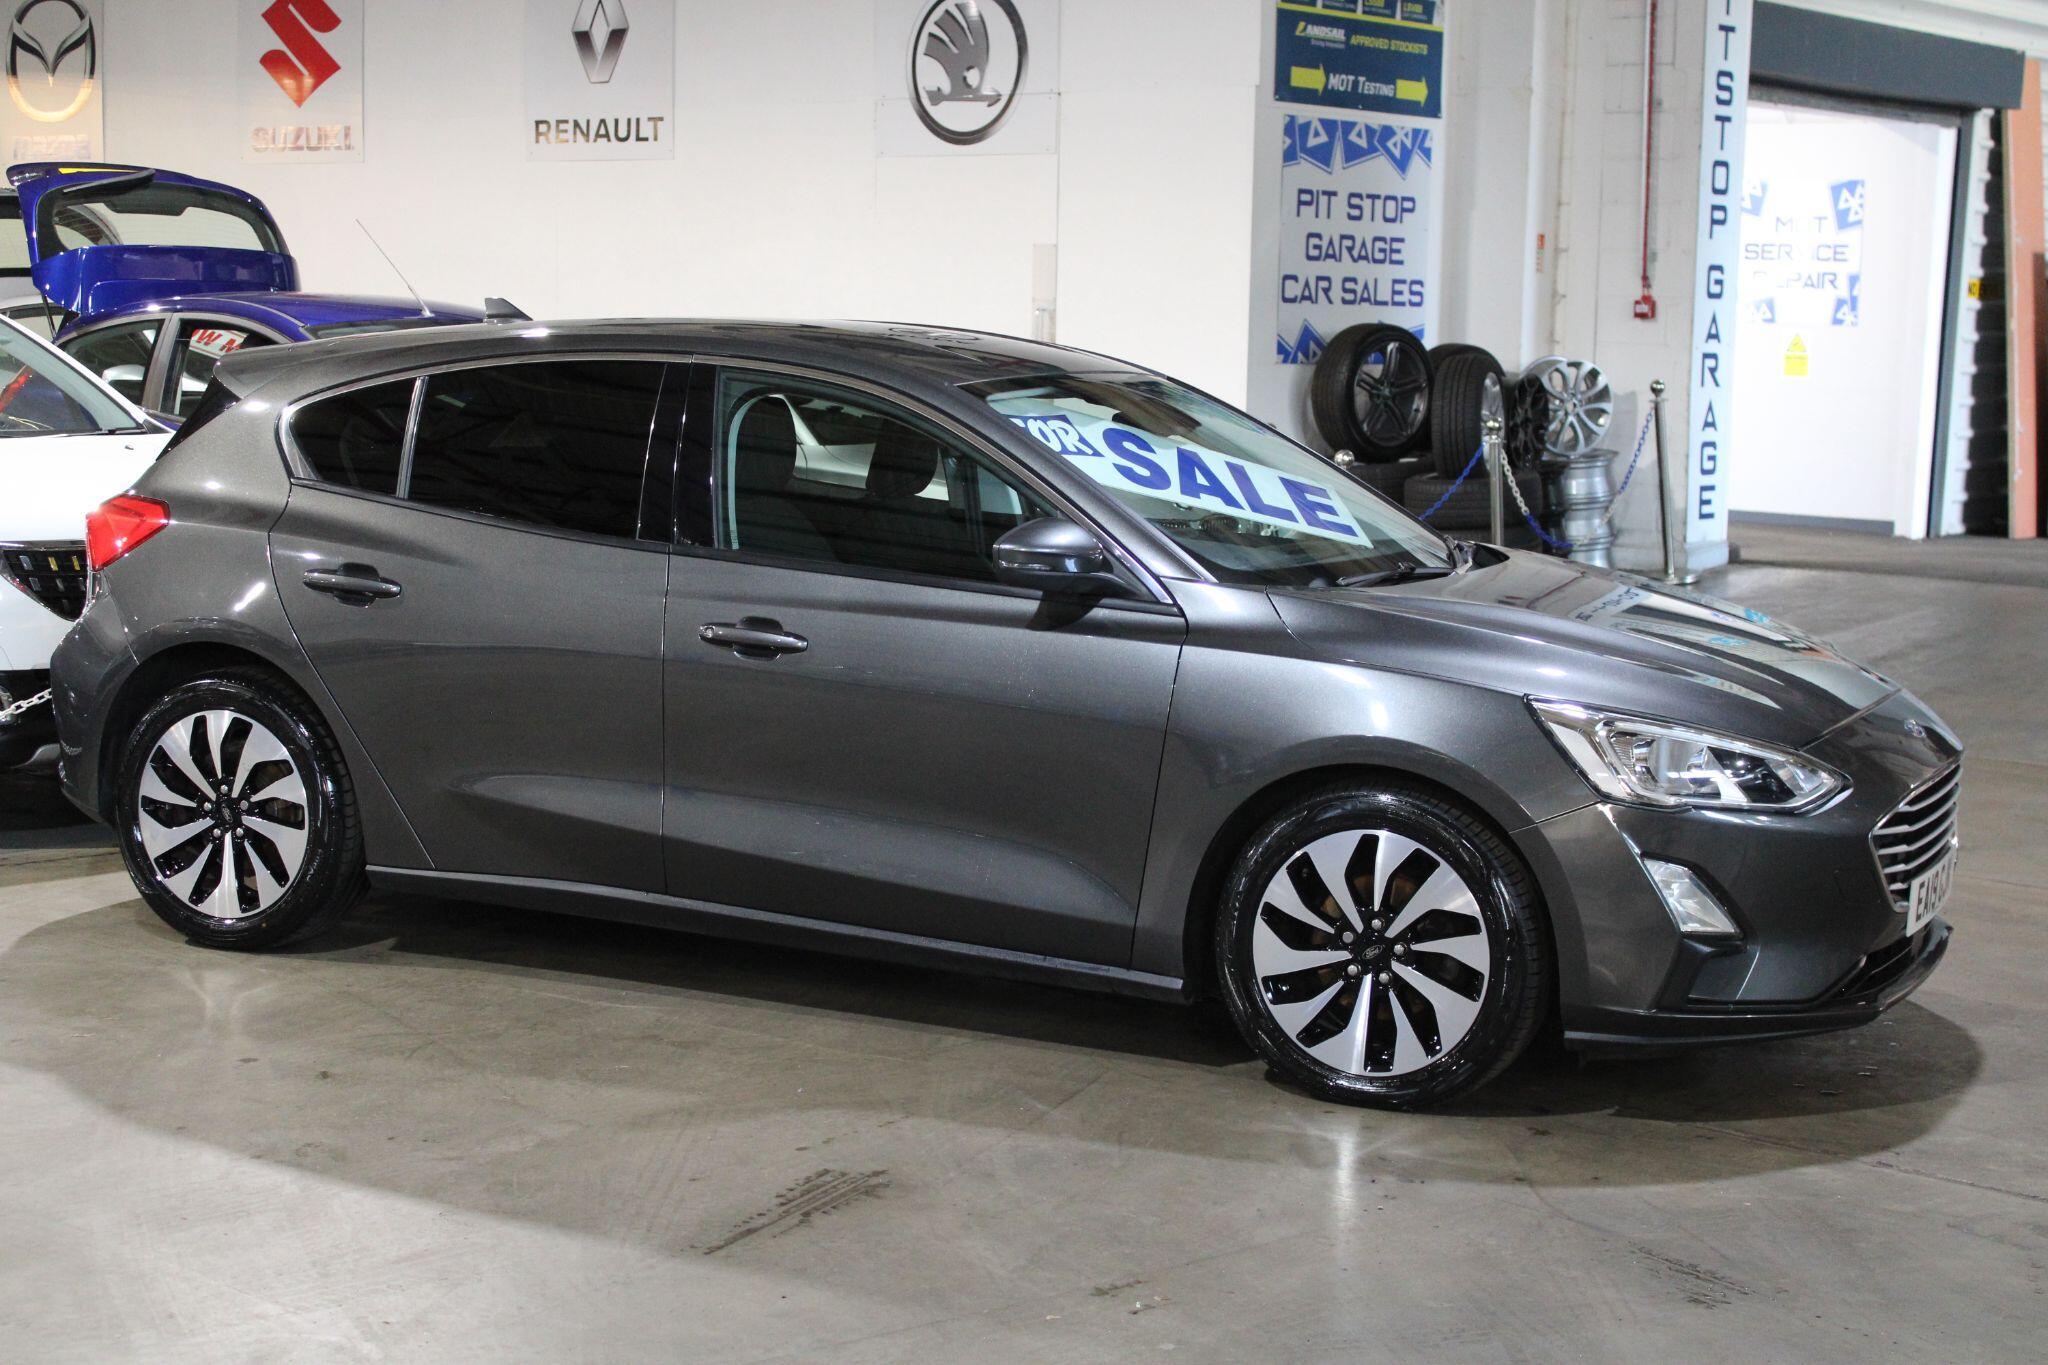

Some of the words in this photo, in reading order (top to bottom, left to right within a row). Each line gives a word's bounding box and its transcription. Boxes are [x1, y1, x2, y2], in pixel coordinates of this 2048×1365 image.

[1351, 34, 1389, 49] APPROVED
[1390, 39, 1428, 55] STOCKISTS
[1328, 73, 1355, 91] MOT
[251, 126, 351, 152] SUZUKI
[534, 116, 664, 144] RENAULT
[1709, 70, 1734, 240] STOP
[1296, 188, 1338, 219] PIT
[1346, 192, 1416, 224] STOP
[1775, 215, 1829, 233] MT
[1305, 232, 1406, 265] GARAGE
[1744, 243, 1848, 262] SERCE
[1281, 274, 1334, 305] CAR
[1341, 276, 1424, 307] SALES
[1698, 264, 1724, 520] GARAGE
[1009, 418, 1093, 455] OR
[1102, 427, 1359, 537] SALE
